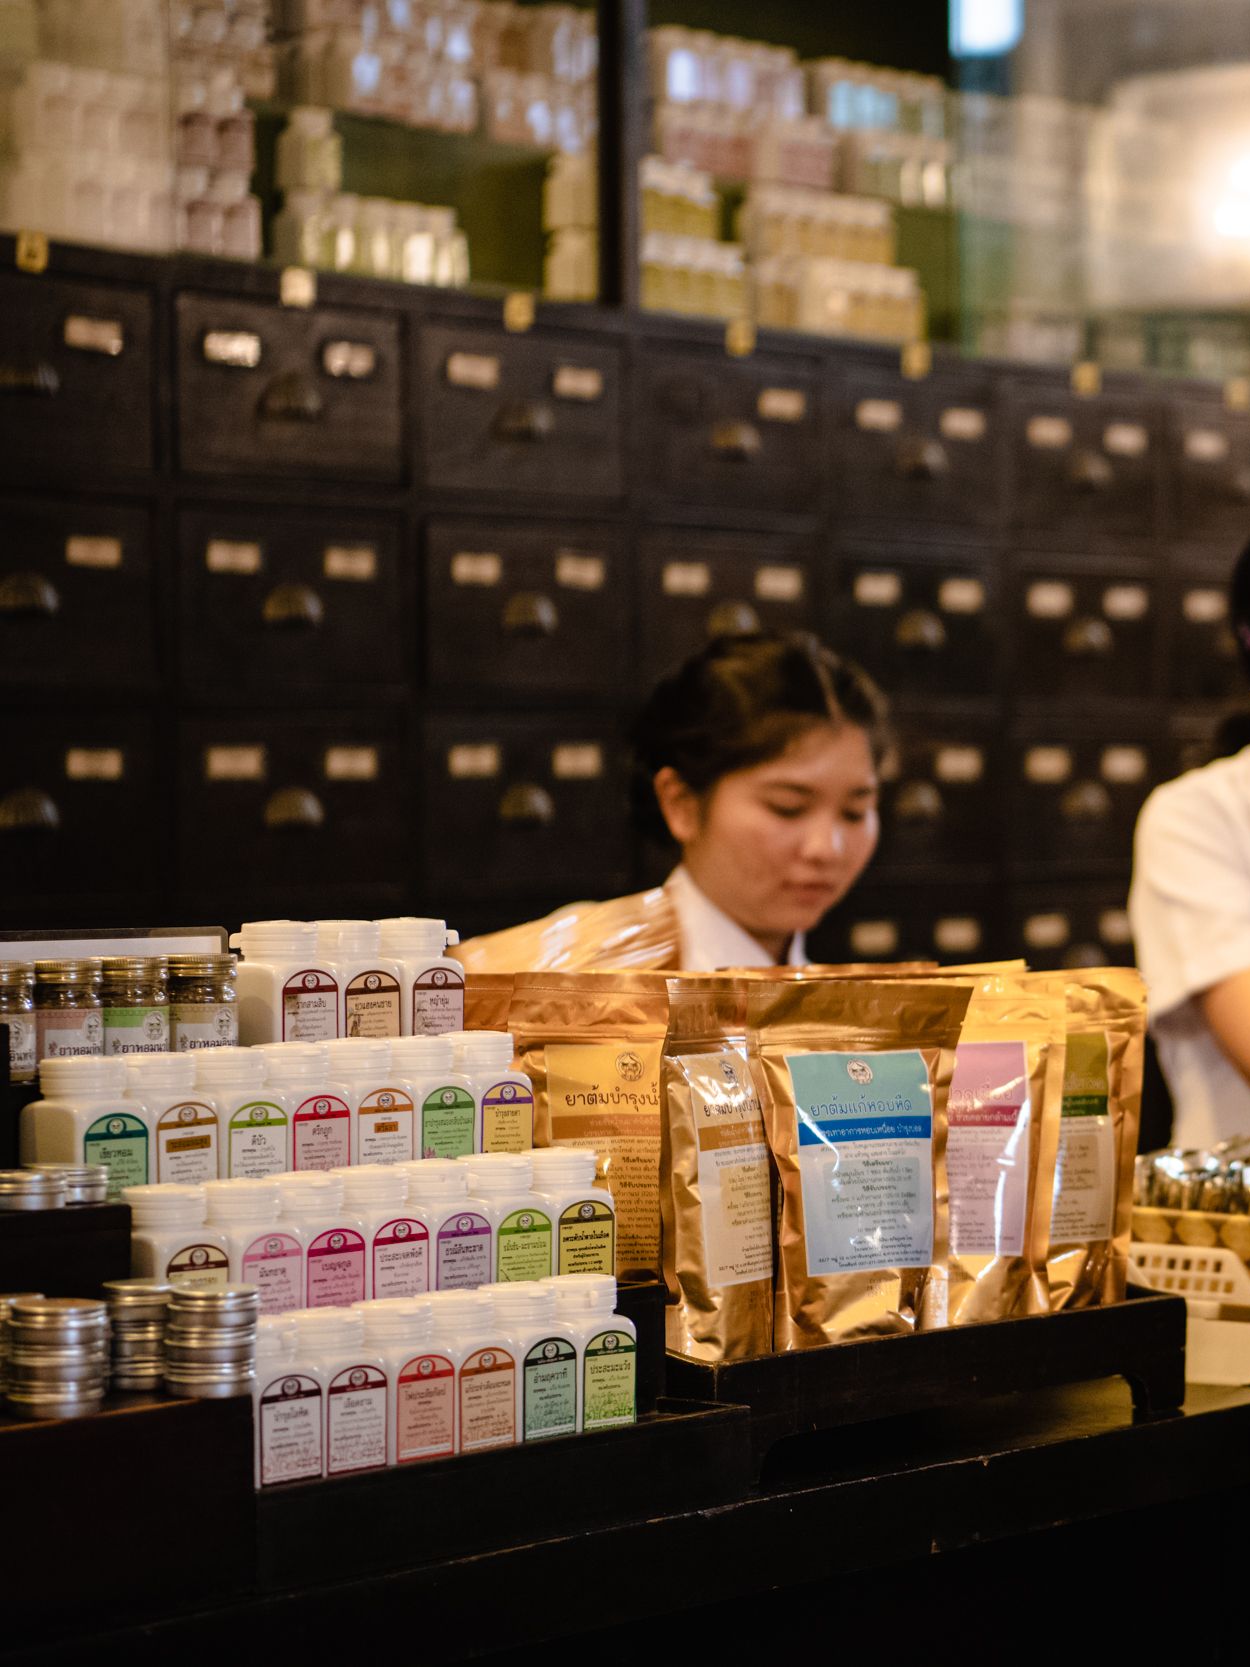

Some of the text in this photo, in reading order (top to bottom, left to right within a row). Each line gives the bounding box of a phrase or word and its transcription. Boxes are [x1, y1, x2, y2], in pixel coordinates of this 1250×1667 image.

[810, 1094, 913, 1117] ยาต้มแก้หอบหืด
